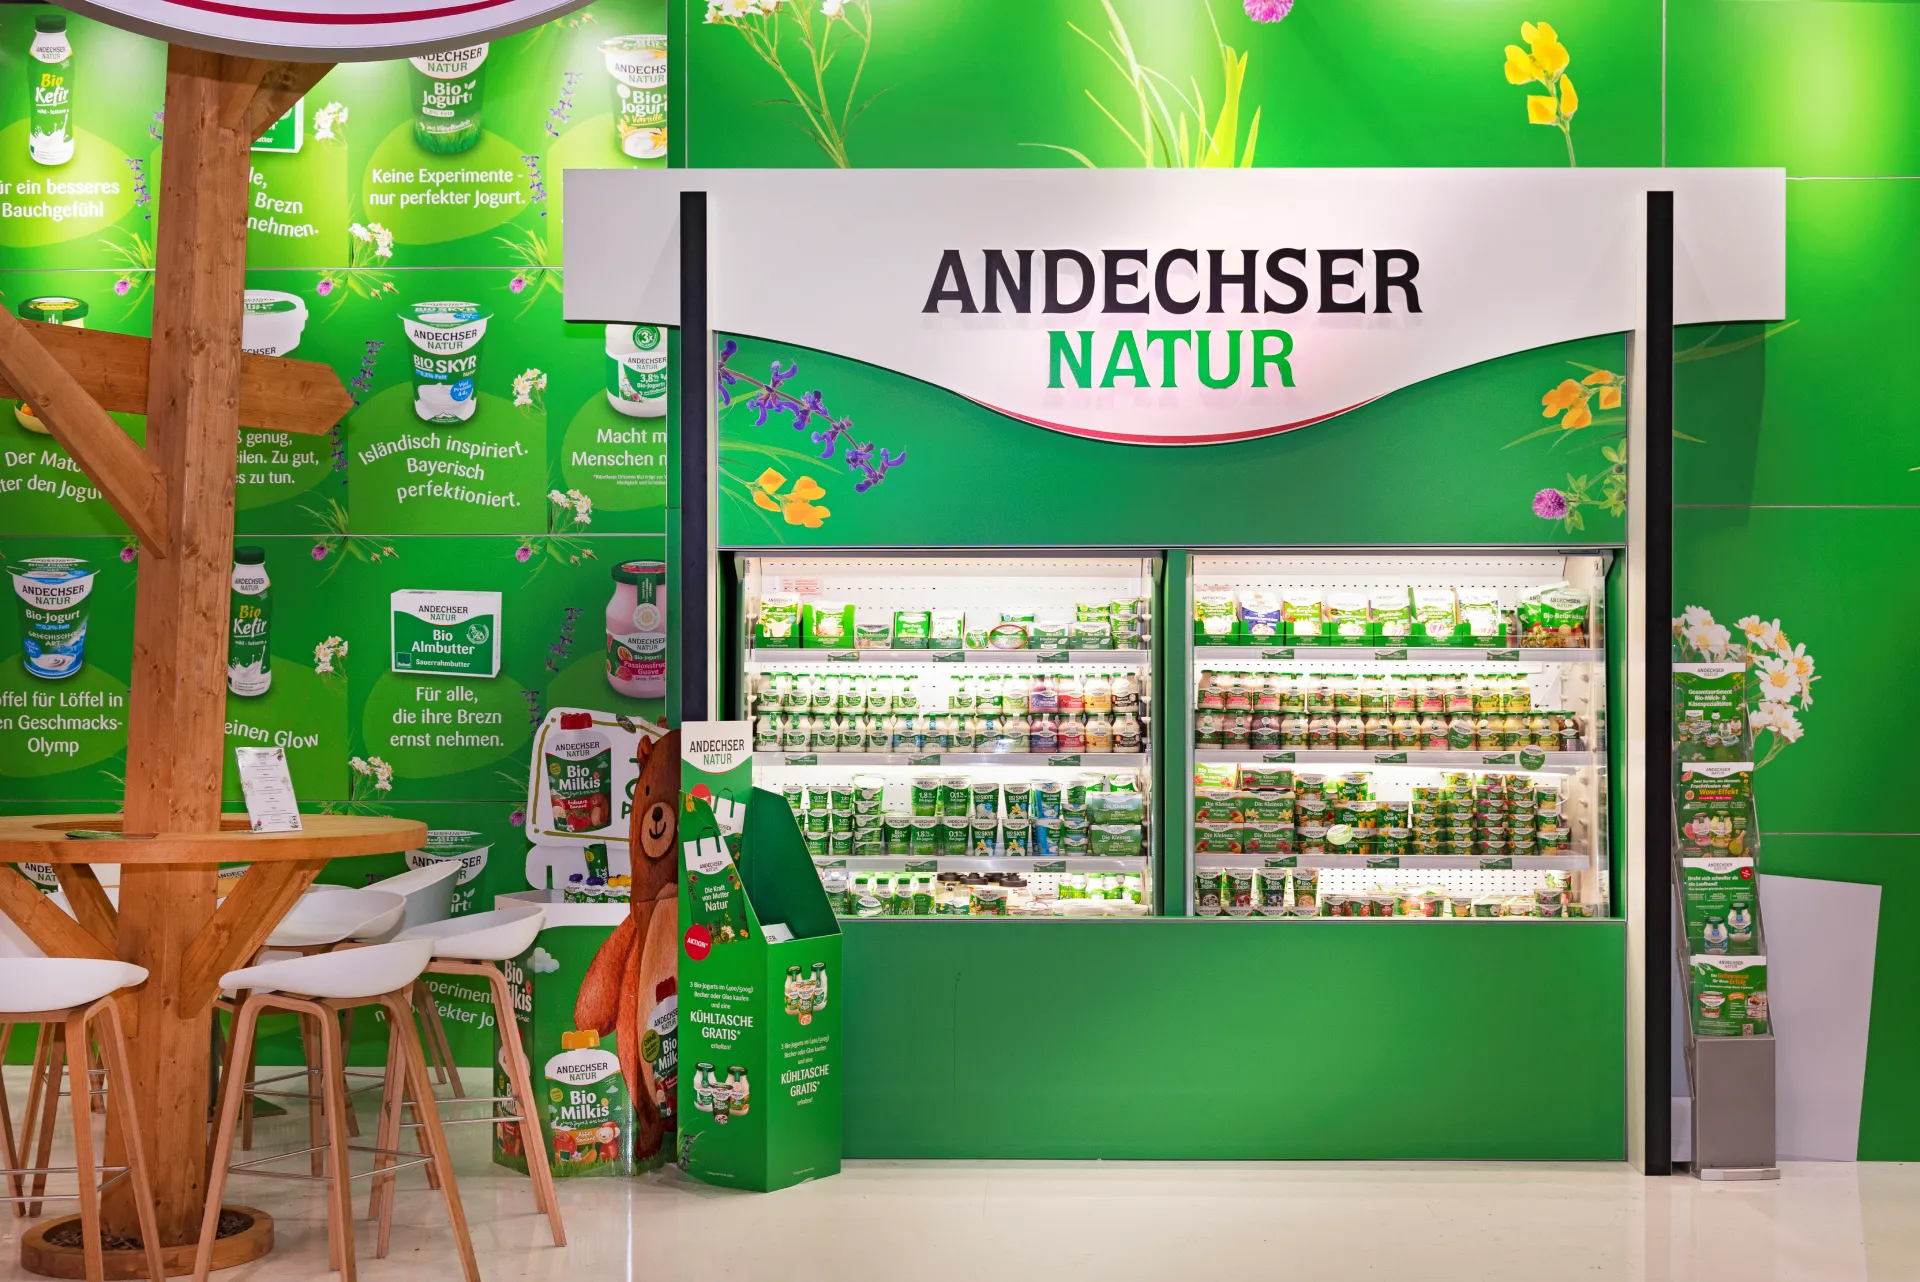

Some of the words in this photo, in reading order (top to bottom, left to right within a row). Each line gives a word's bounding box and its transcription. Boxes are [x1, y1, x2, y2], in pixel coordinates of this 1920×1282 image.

[428, 62, 468, 72] NATUR
[41, 74, 63, 88] Bio
[628, 74, 665, 83] NATUR
[35, 86, 69, 107] Kefir
[434, 82, 461, 96] Bio
[632, 90, 662, 104] Bio
[422, 90, 468, 108] Jogurt
[632, 112, 663, 124] Vanille
[372, 168, 414, 183] Keine
[418, 168, 513, 187] Experimente
[16, 180, 41, 195] ein
[46, 179, 120, 195] besseres
[254, 192, 304, 215] Brezn
[369, 192, 396, 205] nur
[400, 189, 470, 209] perfekter
[474, 189, 526, 208] Jogurt.
[2, 200, 104, 222] Bauchgefühl
[246, 217, 319, 238] nehmen.
[921, 248, 1424, 315] ANDECHSER
[414, 329, 478, 342] ANDECHSER
[428, 342, 464, 350] NATUR
[414, 354, 434, 369] BIO
[436, 356, 477, 374] SKYR
[1046, 328, 1296, 389] NATUR
[246, 432, 293, 446] genug,
[596, 428, 648, 444] Macht
[358, 433, 440, 466] Isländisch
[446, 436, 529, 460] inspiriert.
[5, 451, 36, 468] Der
[271, 450, 288, 464] Zu
[292, 452, 319, 468] gut,
[572, 450, 654, 467] Menschen
[249, 472, 264, 484] zu
[268, 470, 296, 484] tun.
[406, 458, 485, 480] Bayerisch
[27, 477, 56, 493] den
[396, 481, 521, 508] perfektioniert.
[22, 585, 84, 596] ANDECHSER
[36, 596, 71, 605] NATUR
[26, 609, 80, 624] Bio-Jogurt
[240, 604, 262, 618] Bio
[418, 605, 468, 614] ANDECHSER
[430, 613, 457, 622] NATUR
[234, 618, 268, 638] Kefir
[432, 630, 454, 642] Bio
[412, 641, 476, 656] Almbutter
[415, 658, 470, 668] Sauerrahmbutter
[0, 692, 28, 708] ffel
[32, 692, 55, 708] für
[60, 692, 105, 708] Löffel
[109, 692, 123, 708] in
[416, 686, 442, 702] Für
[446, 686, 479, 704] alle,
[18, 714, 122, 731] Geschmacks-
[392, 708, 418, 724] die
[421, 708, 452, 724] ihre
[457, 710, 502, 724] Brezn
[28, 737, 80, 757] Olymp
[274, 732, 319, 749] Glow
[390, 734, 431, 747] ernst
[435, 732, 504, 748] nehmen.
[556, 742, 600, 752] ANDECHSER
[689, 738, 745, 754] ANDECHSER
[566, 750, 590, 758] NATUR
[703, 753, 732, 766] NATUR
[566, 765, 590, 778] Bio
[559, 777, 600, 791] Milkis
[712, 891, 730, 900] Mutter
[714, 884, 726, 892] Kraft
[704, 900, 729, 912] Natur
[504, 960, 522, 984] Bio
[694, 982, 718, 990] Bio-Jogurts
[690, 1010, 754, 1028] KÜHLTASCHE
[662, 1038, 677, 1054] Bio
[556, 1062, 608, 1074] ANDECHSER
[780, 1064, 830, 1084] KÜHLTASCHE
[570, 1072, 597, 1082] NATUR
[570, 1090, 597, 1105] Bio
[561, 1104, 610, 1120] Milkis
